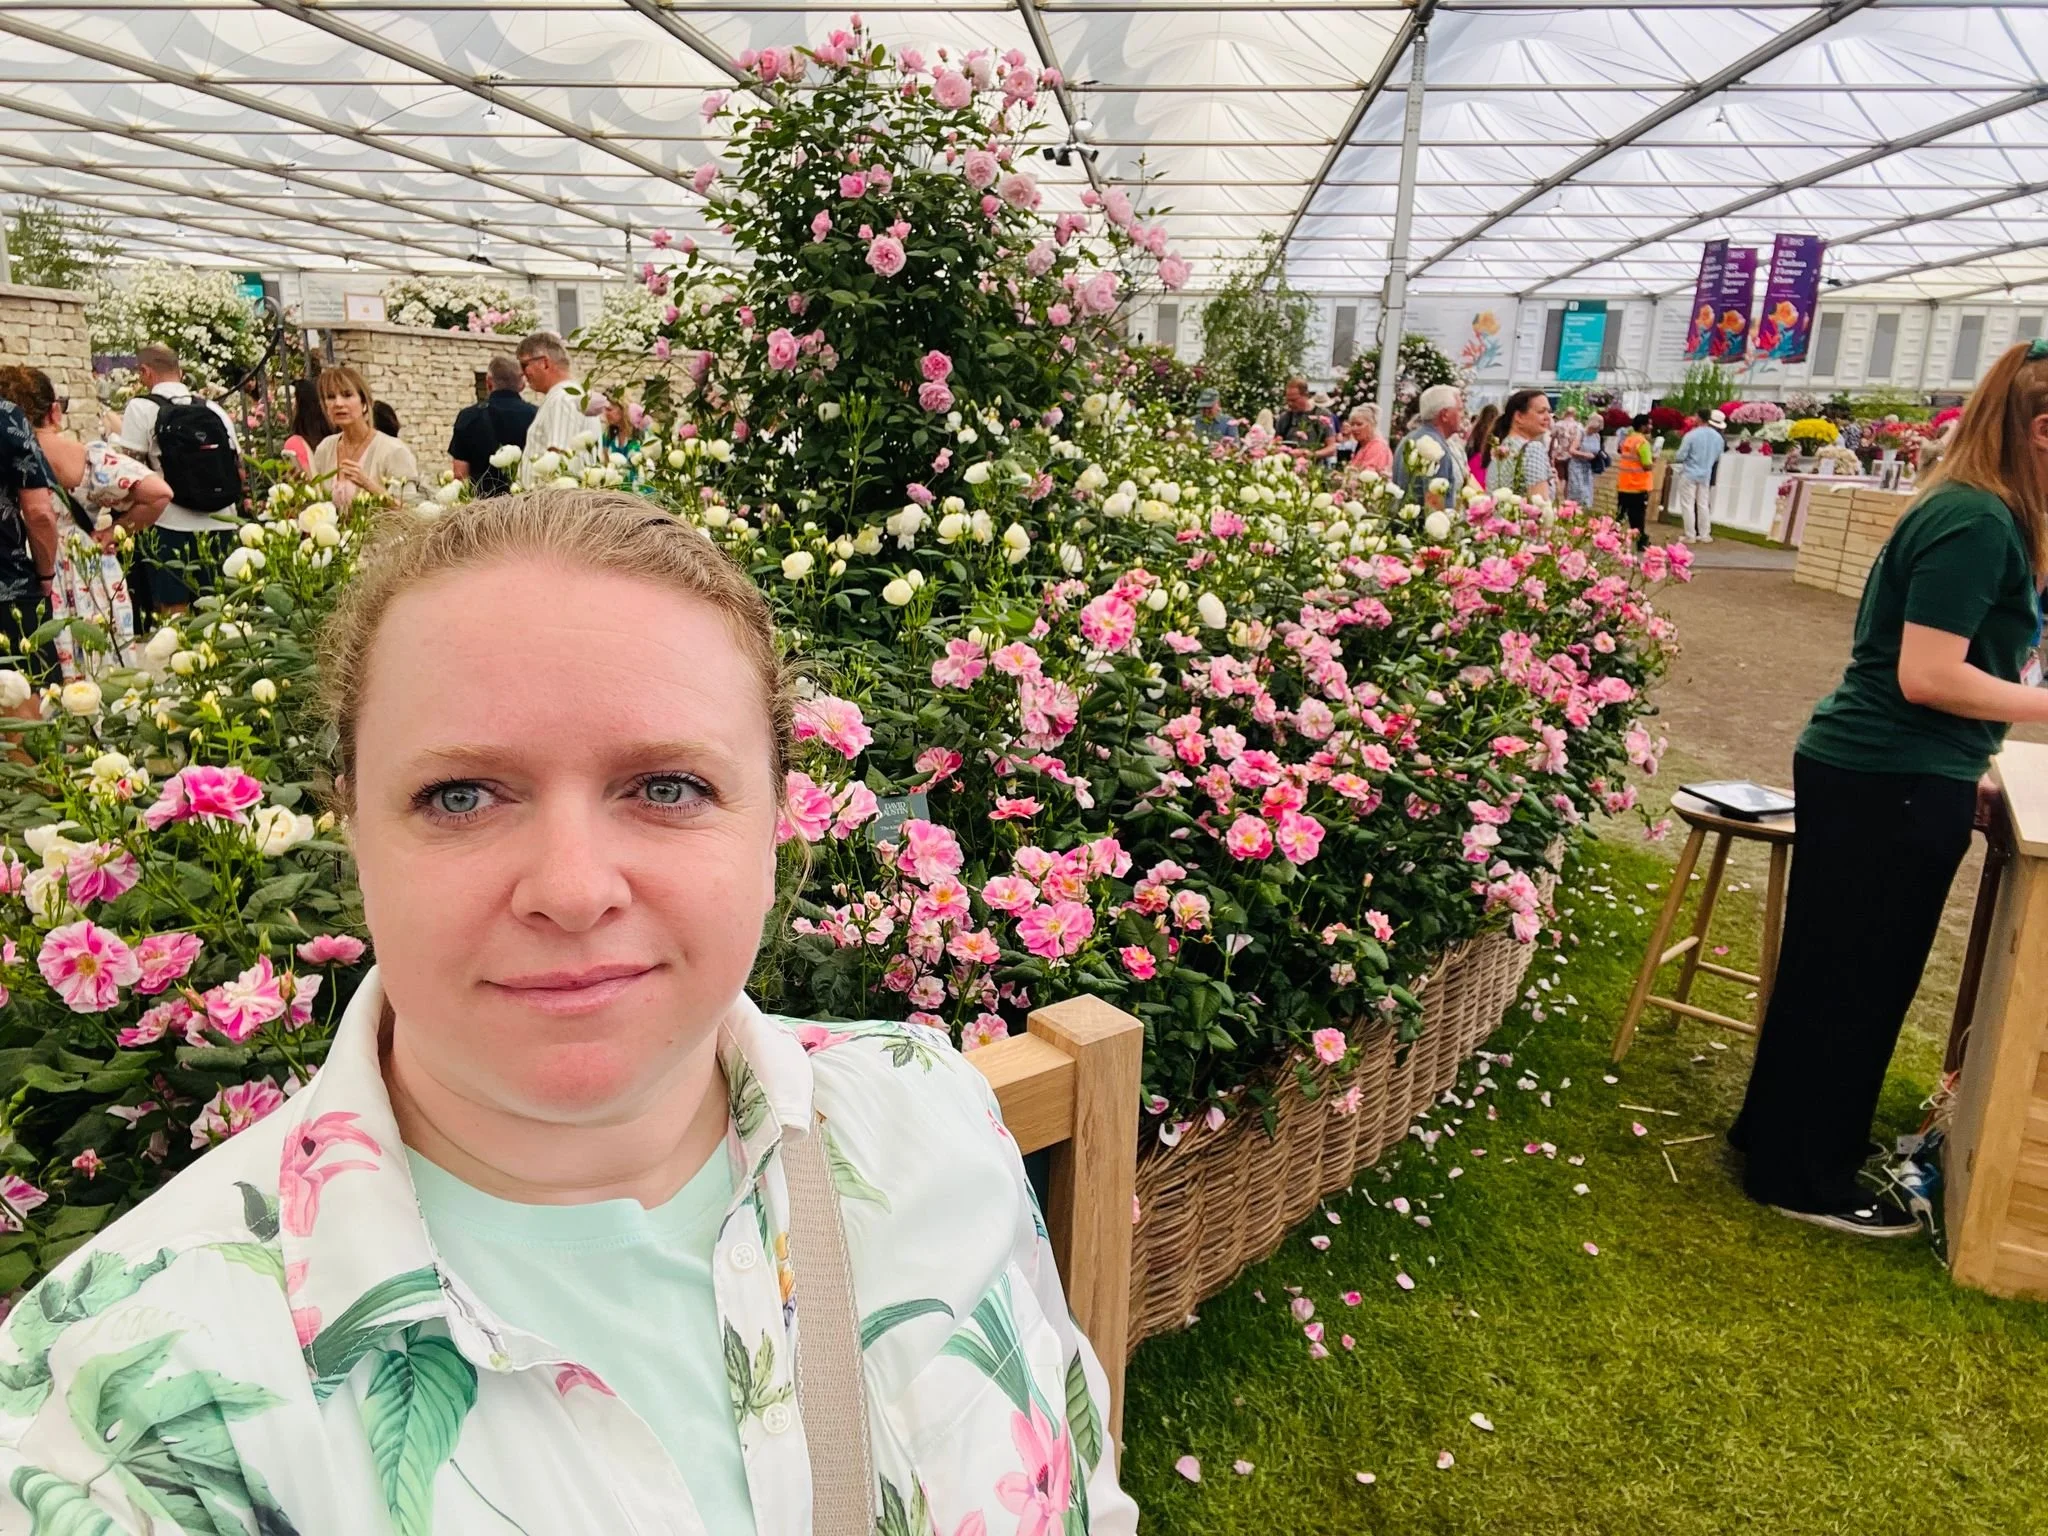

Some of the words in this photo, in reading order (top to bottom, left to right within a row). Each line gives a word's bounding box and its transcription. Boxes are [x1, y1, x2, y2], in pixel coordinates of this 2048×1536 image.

[1775, 267, 1803, 276] Flower
[1773, 275, 1795, 284] Show
[884, 801, 906, 810] DAVID
[883, 808, 909, 816] AUSTIN
